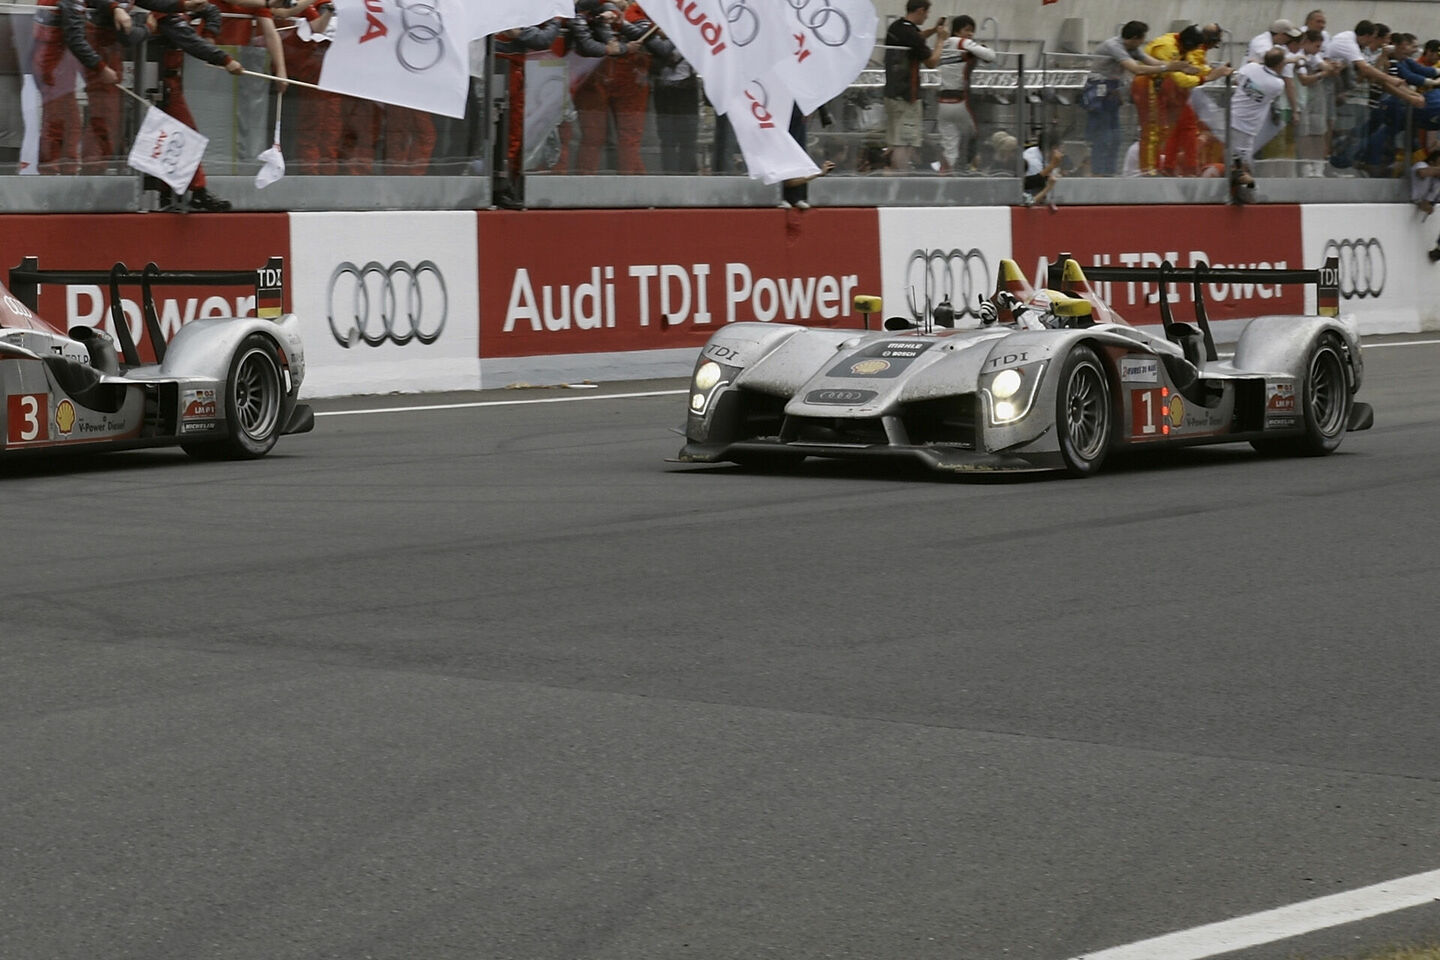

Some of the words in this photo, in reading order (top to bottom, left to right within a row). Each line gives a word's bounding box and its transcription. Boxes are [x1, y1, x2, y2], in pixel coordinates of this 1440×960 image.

[257, 269, 282, 287] TDI
[1319, 268, 1338, 286] TDI
[503, 266, 616, 332] Audi
[629, 263, 711, 326] TDI
[725, 262, 859, 323] Power
[705, 344, 740, 362] TDI
[989, 351, 1029, 368] TDI
[20, 395, 39, 441] 3
[1142, 391, 1156, 434] 1
